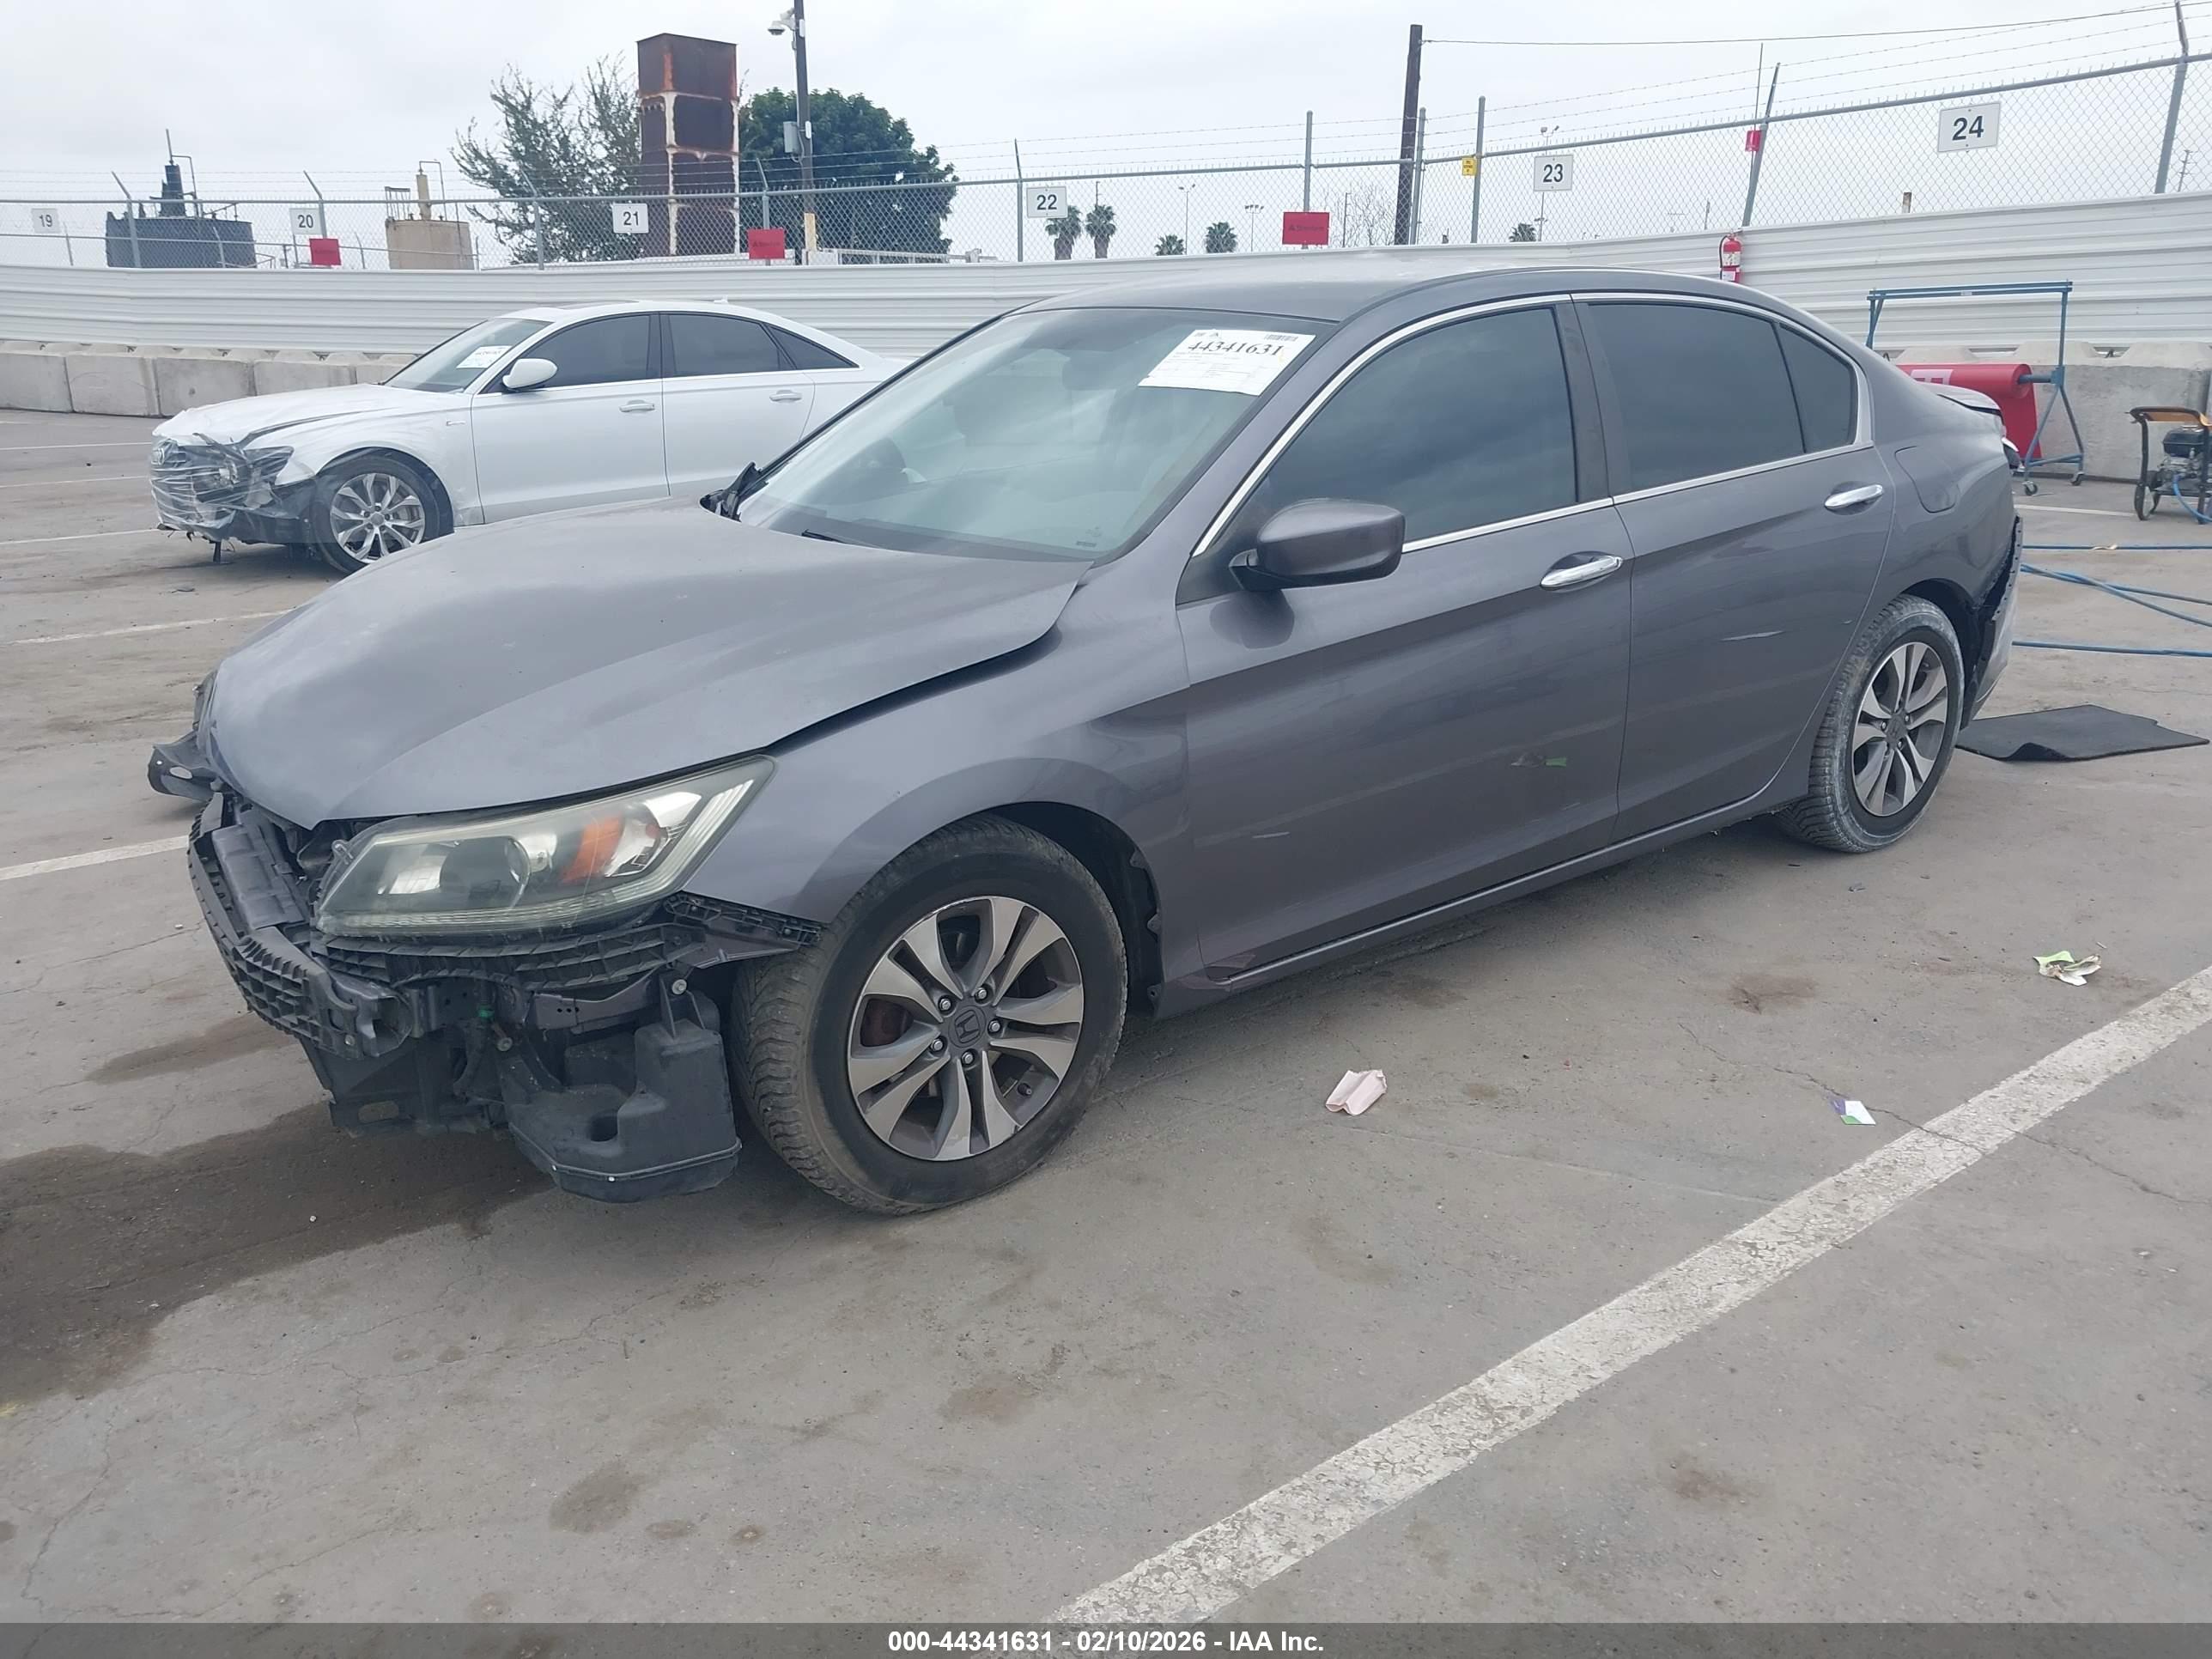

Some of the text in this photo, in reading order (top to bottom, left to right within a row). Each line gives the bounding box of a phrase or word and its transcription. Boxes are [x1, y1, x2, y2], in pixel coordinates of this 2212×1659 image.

[1952, 116, 1984, 141] 24
[1543, 163, 1563, 183] 23
[1036, 194, 1057, 210] 22
[39, 214, 53, 228] 19
[297, 214, 313, 228] 20
[623, 211, 639, 226] 21
[1188, 340, 1285, 356] 44341631
